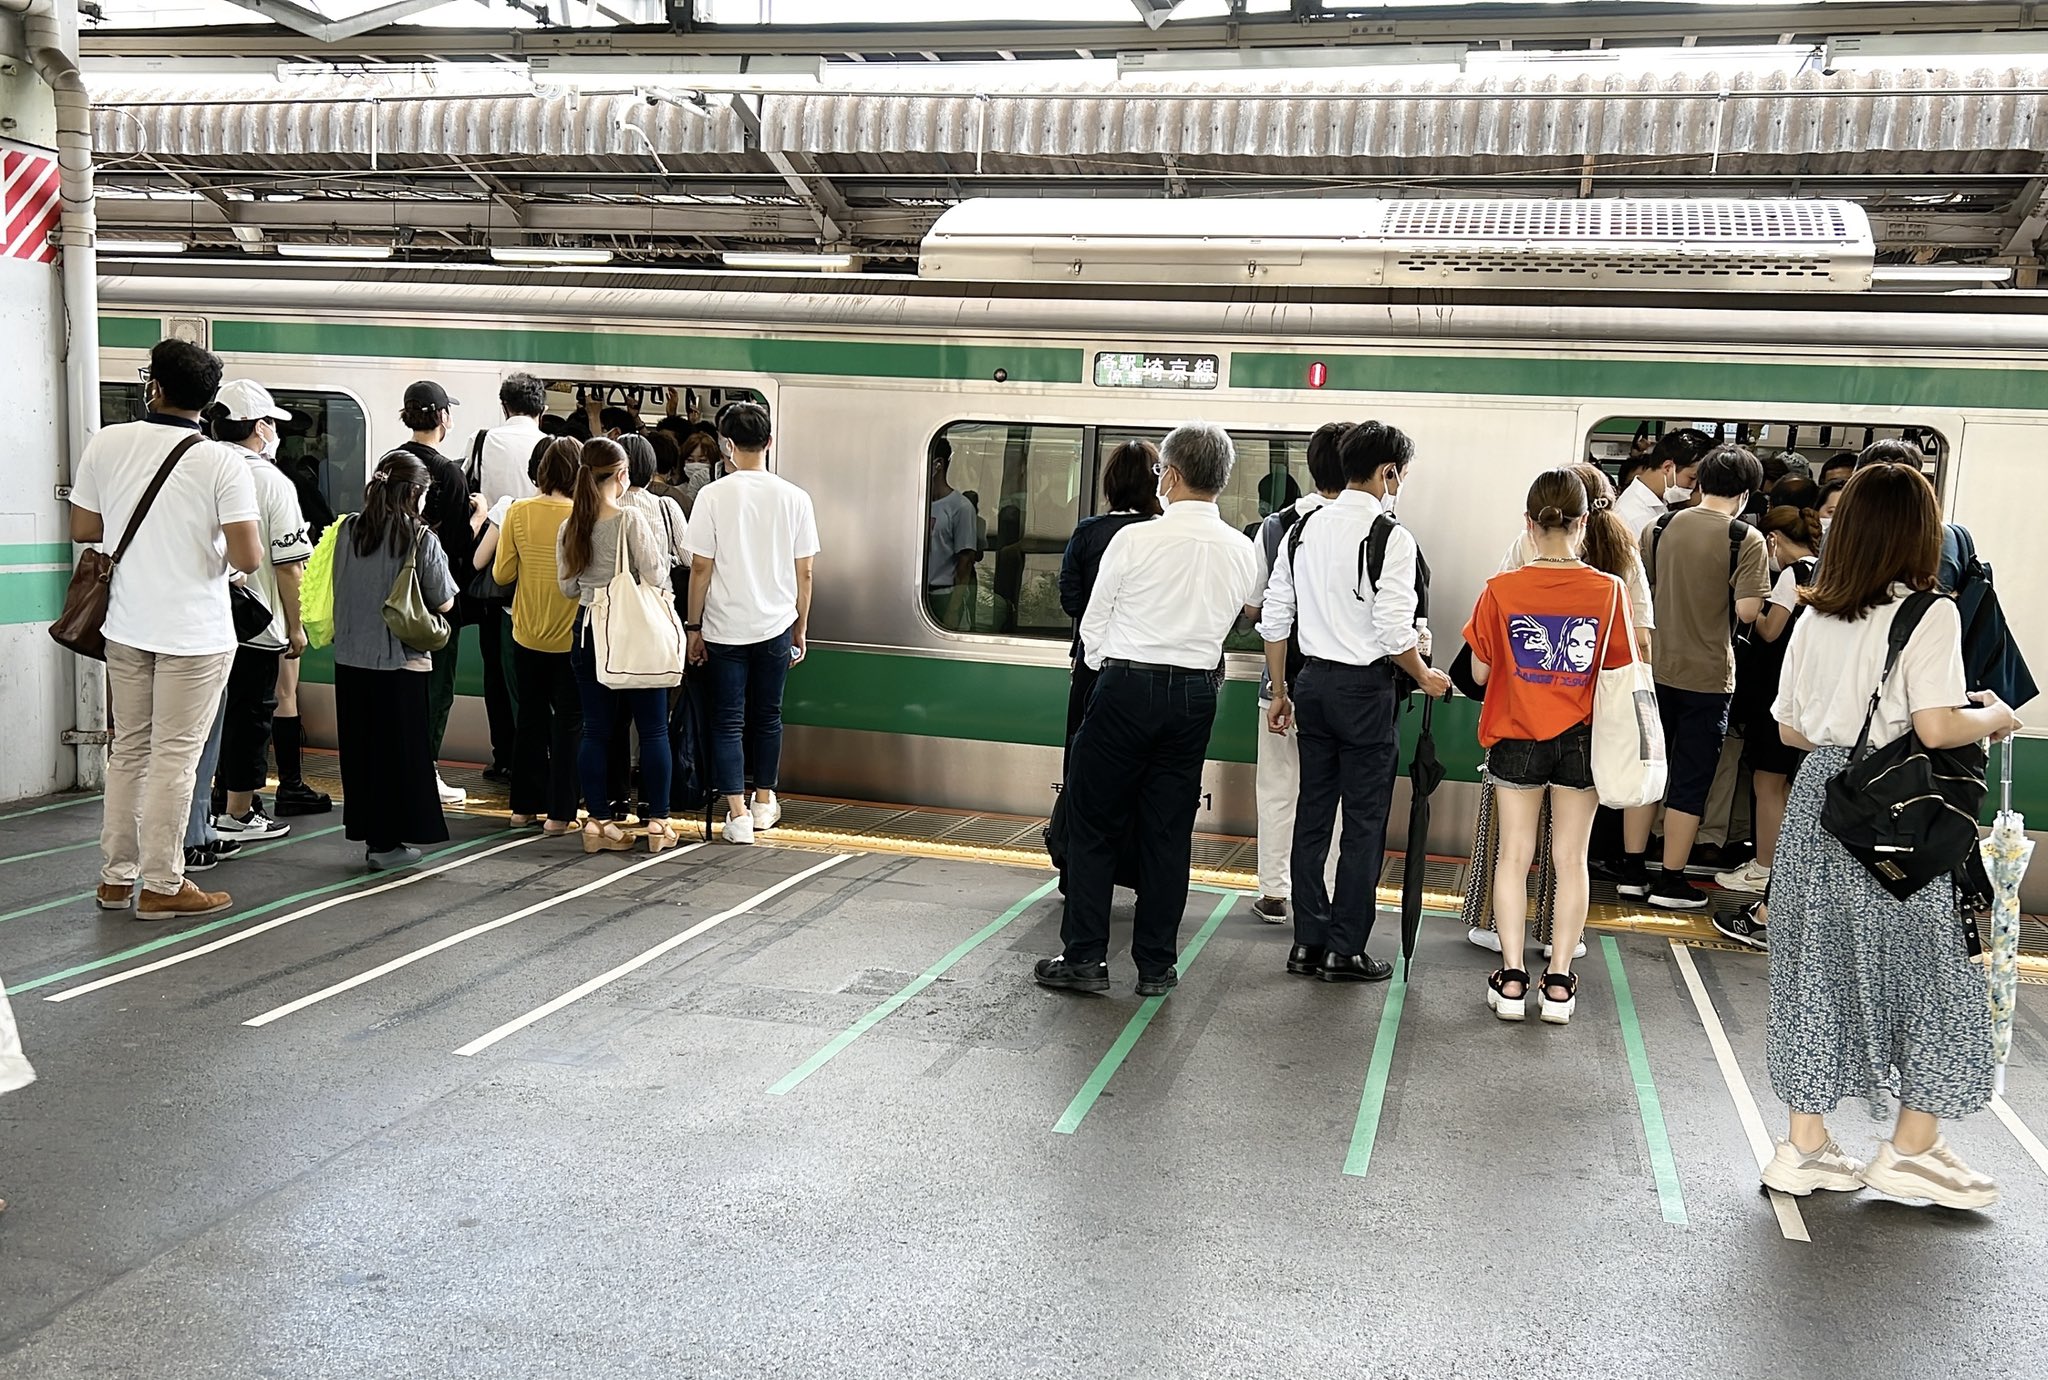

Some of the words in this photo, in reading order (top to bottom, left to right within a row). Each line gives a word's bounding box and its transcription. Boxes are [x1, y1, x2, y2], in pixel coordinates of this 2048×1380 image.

[1143, 357, 1216, 382] 埼京線
[1733, 920, 1749, 934] N
